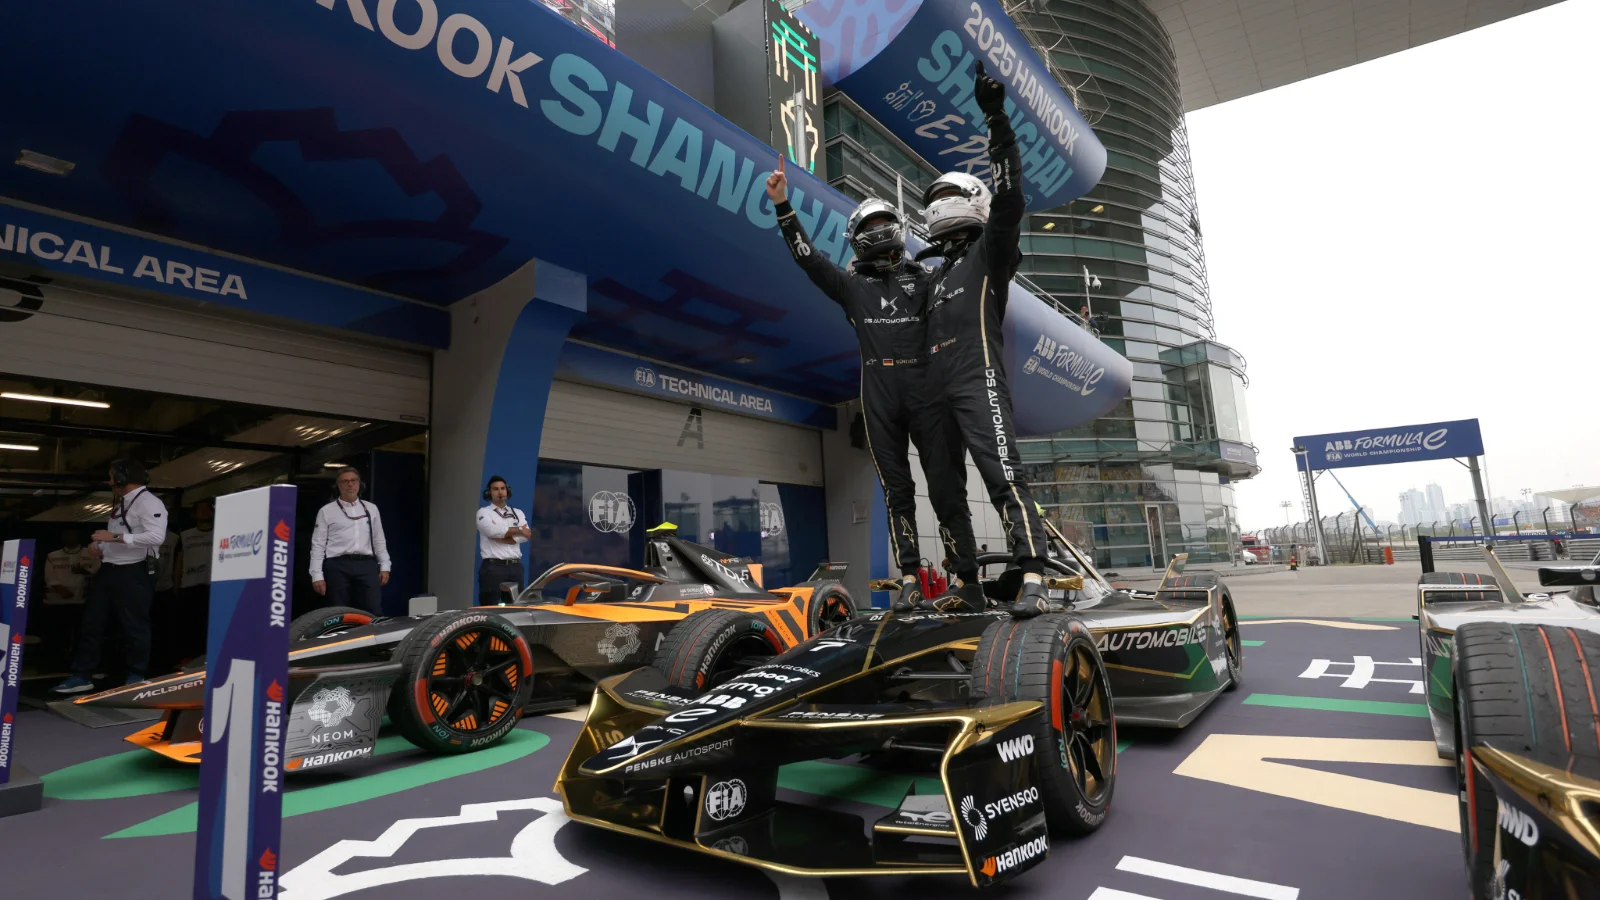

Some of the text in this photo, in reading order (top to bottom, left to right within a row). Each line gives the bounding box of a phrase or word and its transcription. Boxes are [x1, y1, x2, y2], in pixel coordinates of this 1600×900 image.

[964, 2, 1079, 156] 2025 HANKOOK
[540, 53, 850, 272] SHANGHA
[915, 114, 994, 192] E-PR
[133, 255, 248, 300] AREA
[1033, 334, 1057, 361] ABB
[1050, 345, 1095, 383] FORMULA
[1037, 366, 1054, 379] WORLD
[659, 374, 738, 406] TECHNICAL
[739, 394, 773, 412] AREA
[676, 407, 704, 449] A
[985, 368, 1015, 481] DS AUTOMOBILES
[1325, 440, 1353, 452] ABB
[1354, 431, 1423, 450] FORMULA
[1326, 452, 1342, 461] FIA
[1370, 447, 1421, 456] CHAMPIONSHIP
[591, 498, 633, 526] FIA
[16, 565, 29, 608] Hankook
[270, 539, 288, 628] Hankook
[711, 558, 750, 589] TDK
[741, 570, 749, 580] 5
[439, 614, 488, 640] Hankook
[1096, 621, 1207, 652] AUTOMOBILES
[8, 643, 20, 687] Hankook
[700, 624, 737, 675] Hankook
[132, 680, 204, 701] McLaren
[634, 689, 692, 704] PENSK
[689, 694, 747, 709] ABB
[263, 701, 282, 793] Hankook
[311, 729, 354, 744] NEOM
[302, 746, 373, 768] Hankook
[625, 738, 735, 773] PENSKE AUTOSPORT
[708, 790, 745, 815] FIA
[985, 786, 1039, 819] SYENSQO
[996, 835, 1048, 873] Hankook
